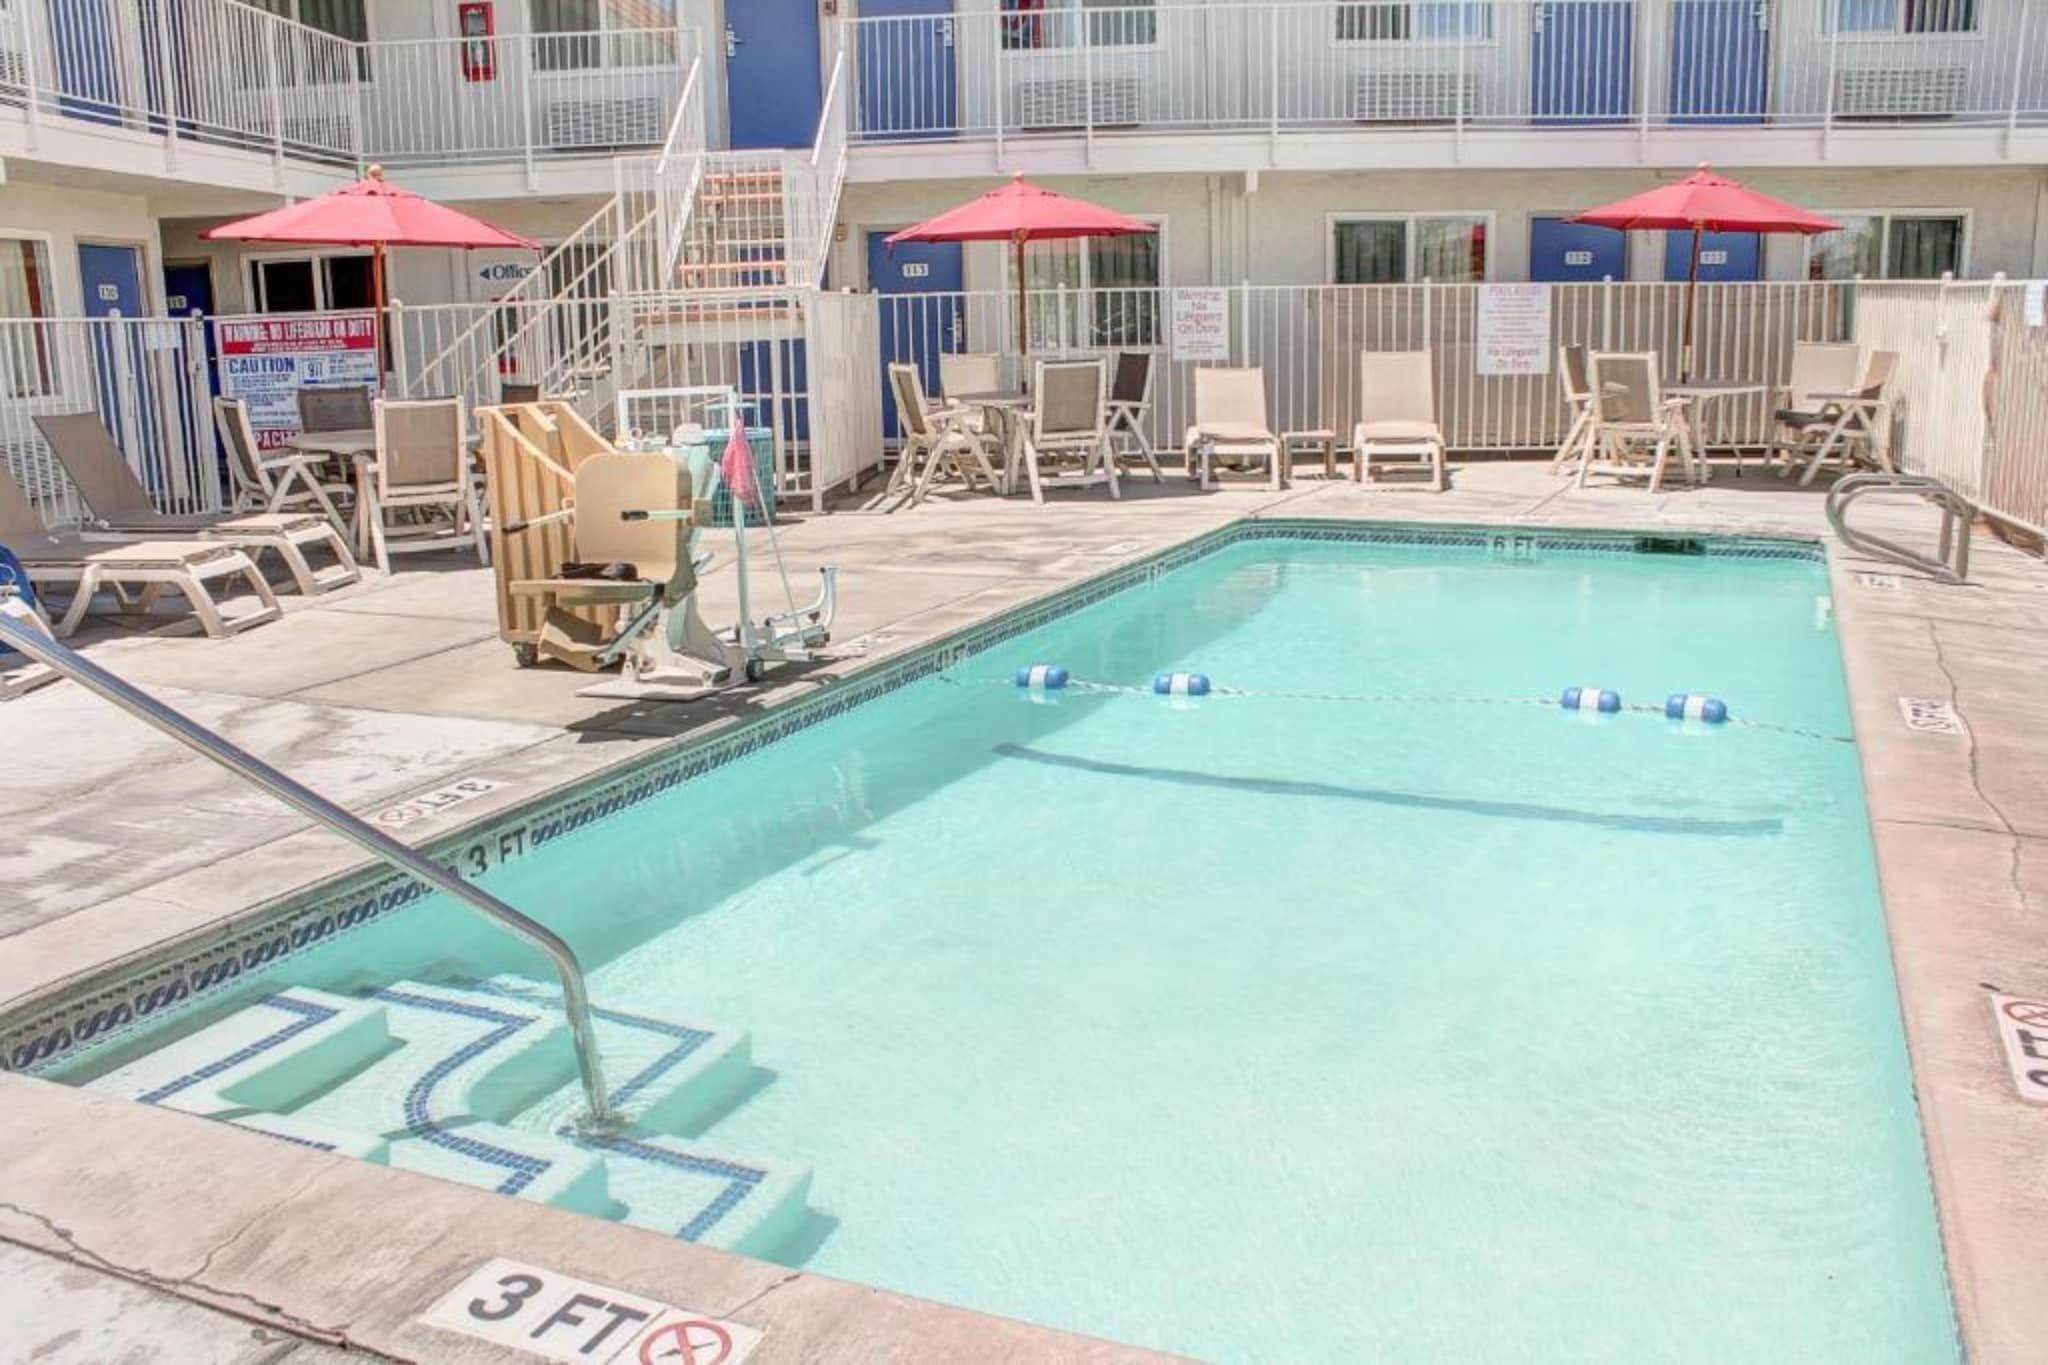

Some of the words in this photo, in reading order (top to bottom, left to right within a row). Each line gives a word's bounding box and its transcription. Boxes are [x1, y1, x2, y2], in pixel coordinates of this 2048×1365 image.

[270, 321, 283, 340] NO
[229, 357, 295, 374] CAUTION
[307, 362, 324, 377] 911
[1514, 536, 1535, 551] FT
[468, 844, 489, 878] 3
[499, 826, 527, 864] FT
[467, 1273, 545, 1322] 3
[529, 1292, 651, 1355] FT
